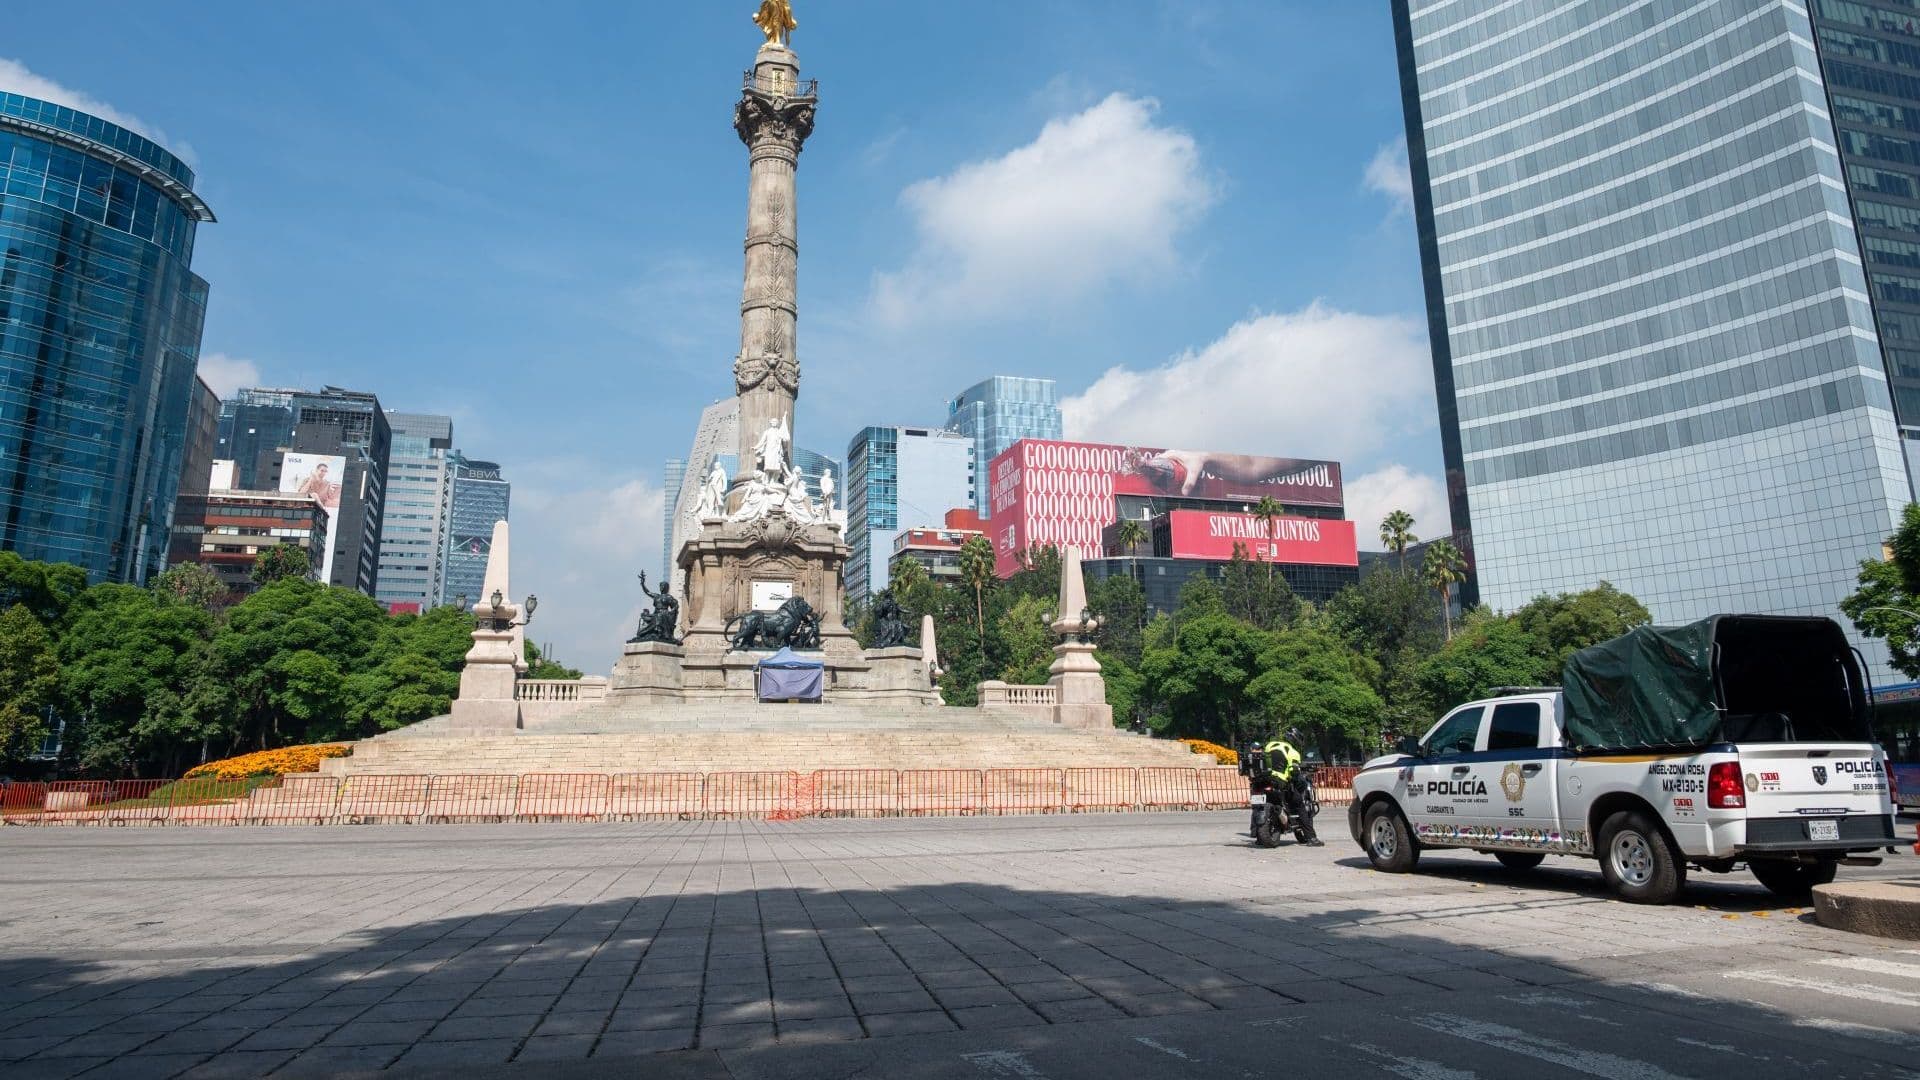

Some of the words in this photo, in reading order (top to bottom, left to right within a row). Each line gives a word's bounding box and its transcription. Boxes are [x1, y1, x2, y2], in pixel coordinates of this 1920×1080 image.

[469, 469, 498, 479] BBVA
[1210, 516, 1270, 539] SINTAMOS
[1275, 517, 1320, 542] JUNTOS
[1688, 764, 1706, 775] ROSA
[1835, 758, 1883, 773] POLICÍA
[1427, 775, 1488, 795] POLICÍA
[1508, 807, 1525, 816] SSC
